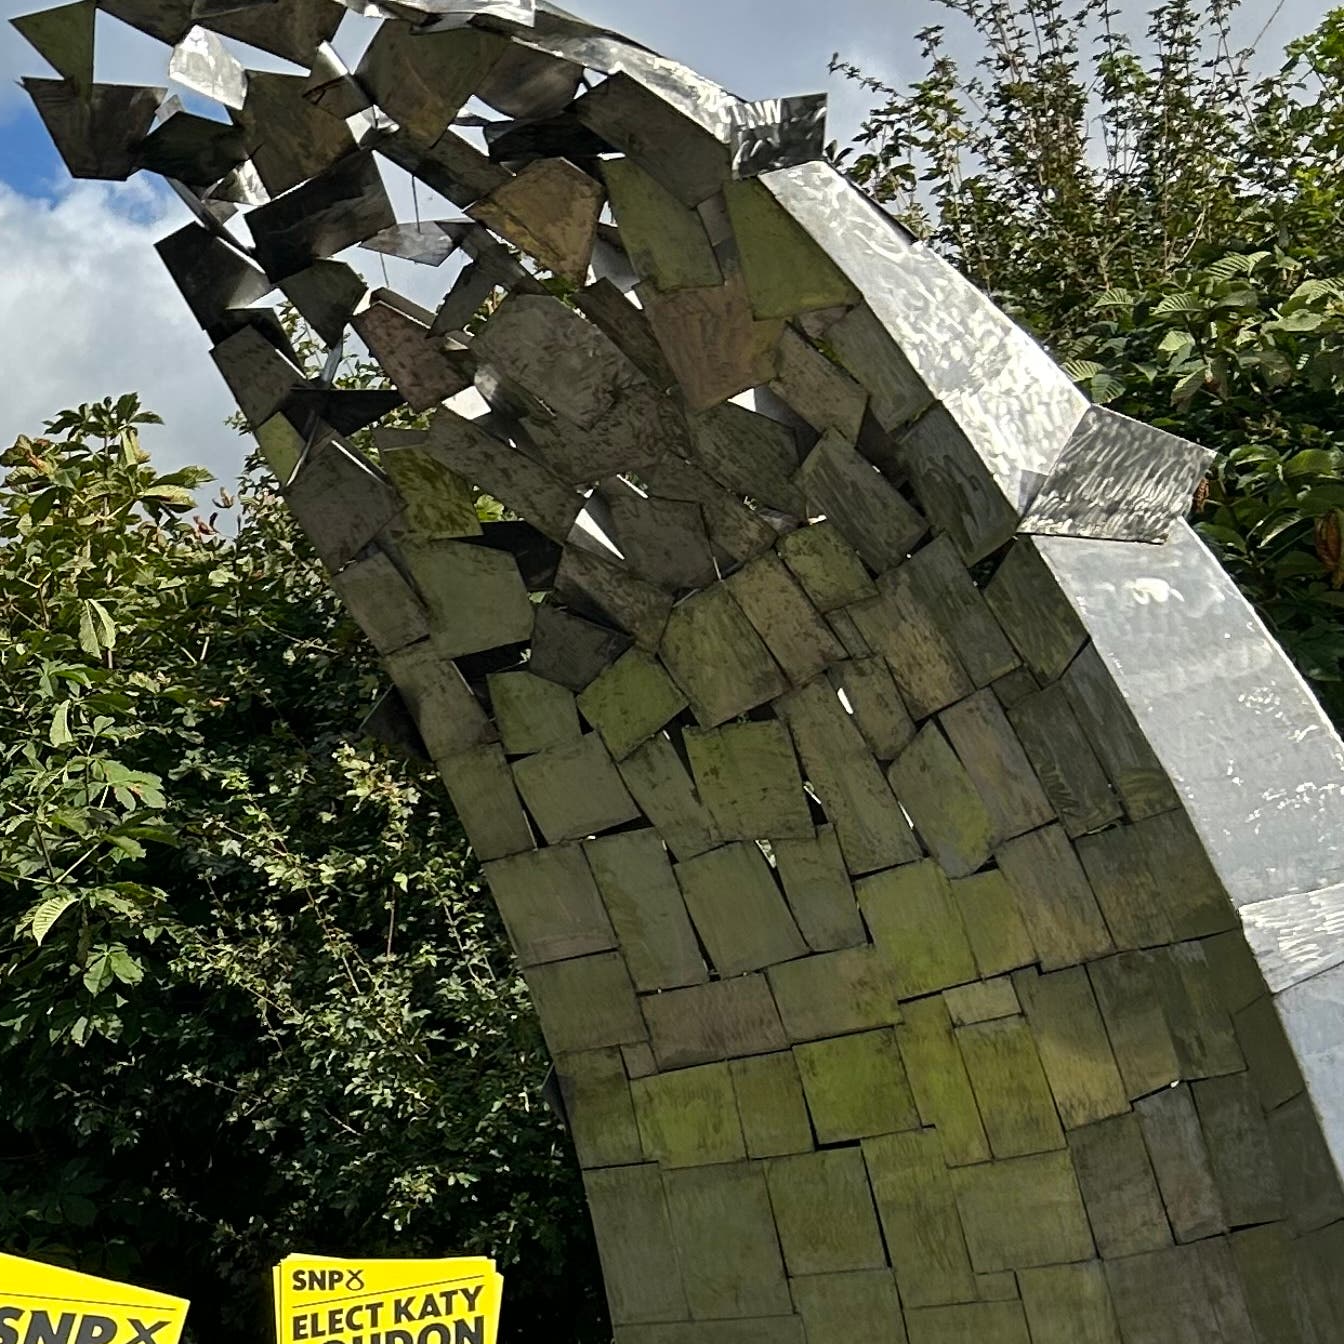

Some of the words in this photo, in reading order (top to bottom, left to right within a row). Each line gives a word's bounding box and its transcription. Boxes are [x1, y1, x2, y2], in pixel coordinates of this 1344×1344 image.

[292, 1270, 344, 1291] SNP
[292, 1302, 384, 1341] ELECT
[394, 1285, 484, 1324] KATY
